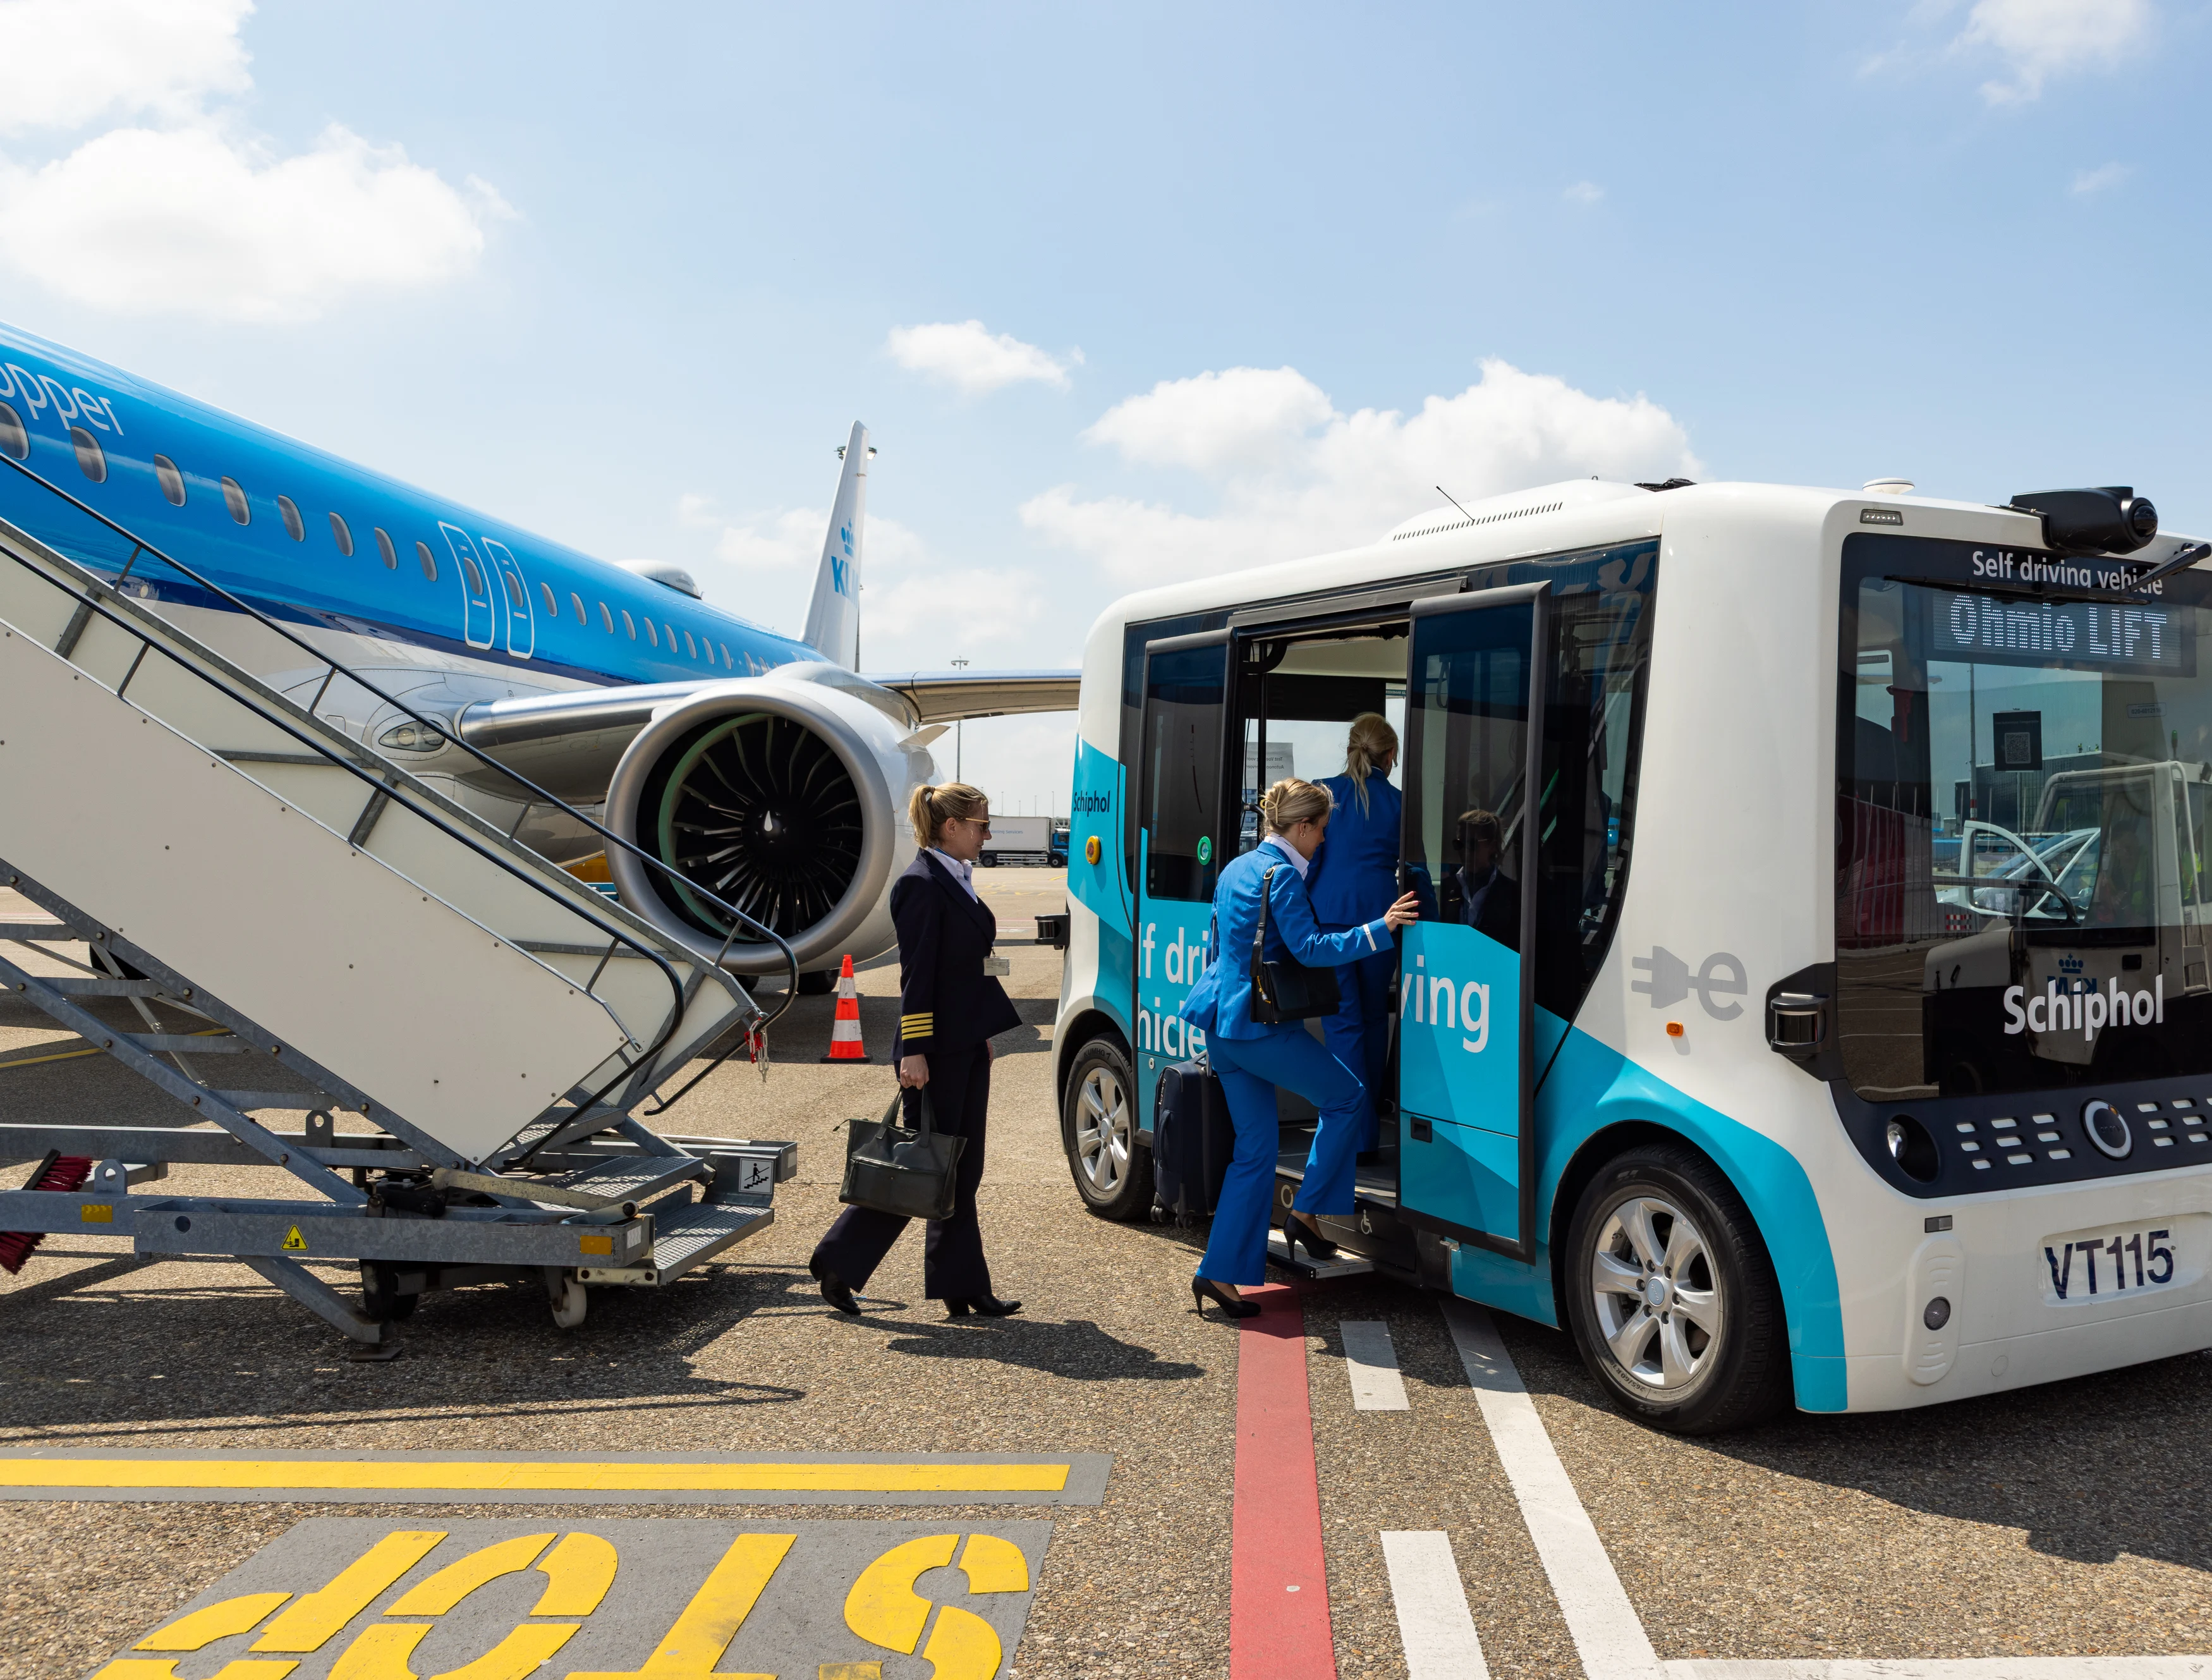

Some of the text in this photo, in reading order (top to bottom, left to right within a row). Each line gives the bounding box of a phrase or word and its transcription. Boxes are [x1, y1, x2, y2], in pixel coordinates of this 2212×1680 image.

[831, 555, 859, 609] KLM
[1972, 551, 2014, 578] Self
[2020, 555, 2092, 588] driving
[1951, 587, 2167, 659] Ohmio LIFT
[1074, 790, 1110, 817] Schiphol
[2003, 974, 2163, 1041] Schiphol
[2045, 1230, 2174, 1300] VT115
